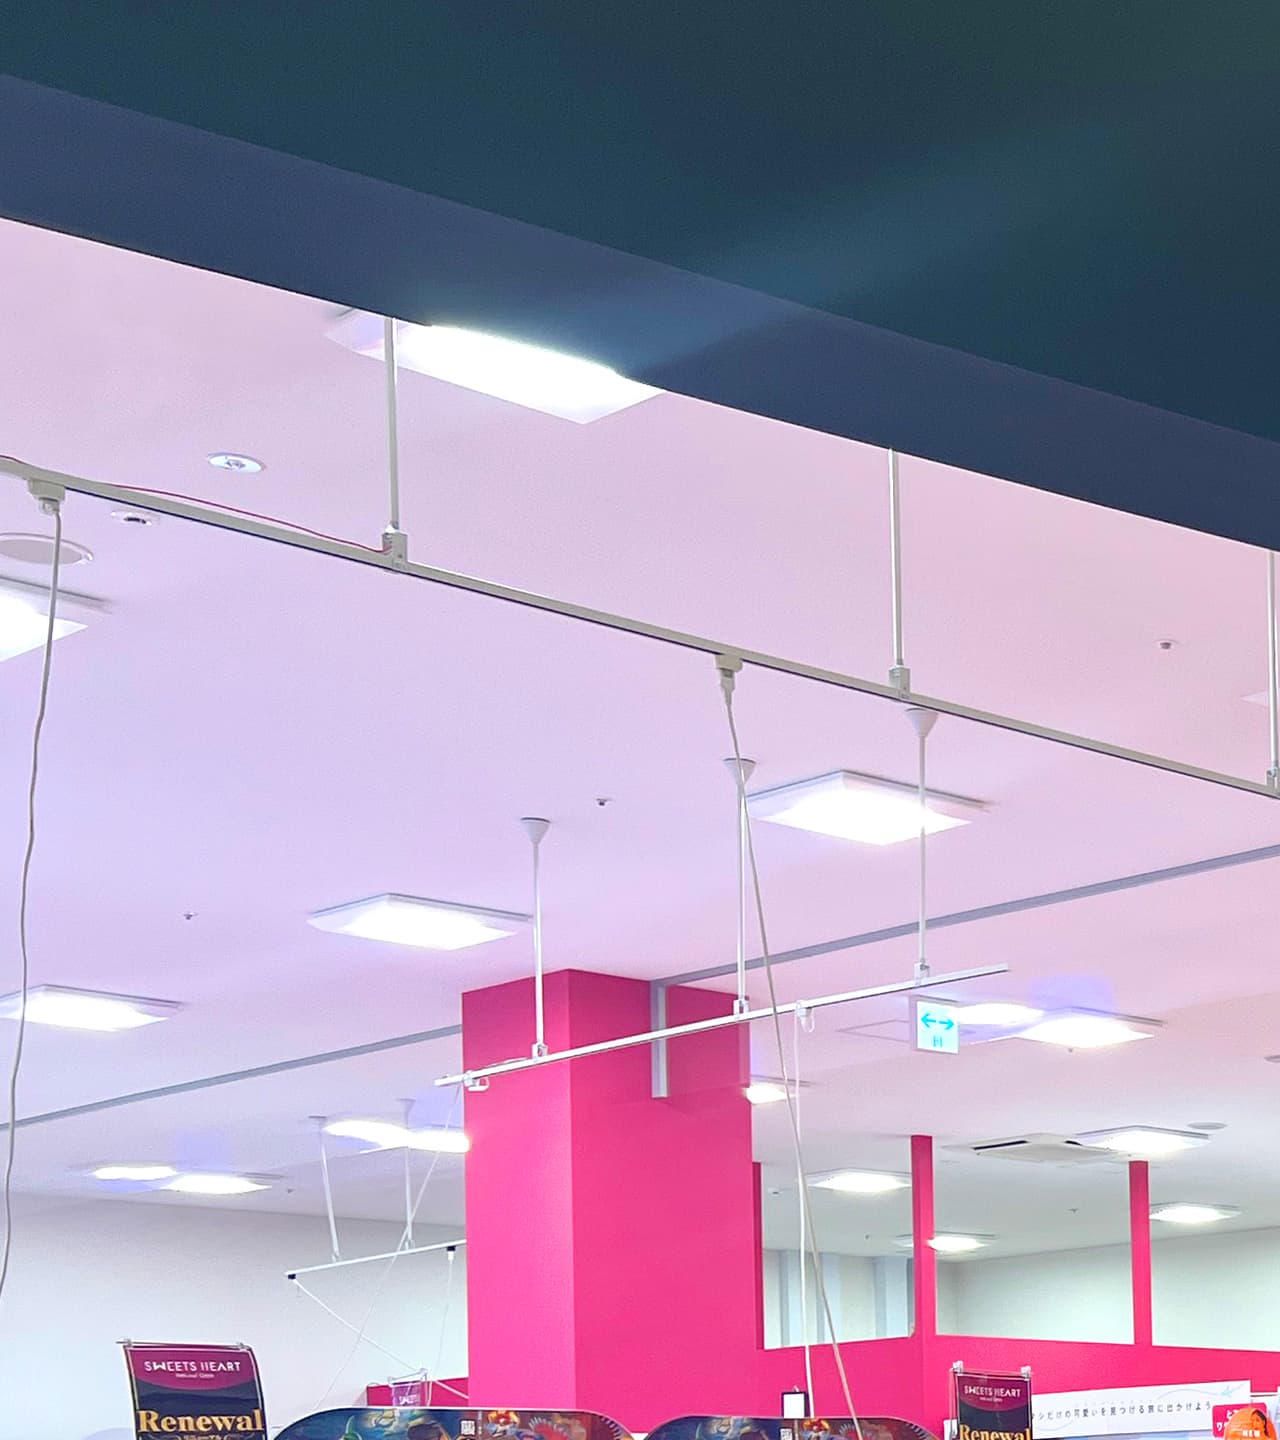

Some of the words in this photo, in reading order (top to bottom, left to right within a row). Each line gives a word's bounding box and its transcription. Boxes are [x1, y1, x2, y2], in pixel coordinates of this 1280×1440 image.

[144, 1361, 197, 1372] SWEETS
[200, 1361, 241, 1372] HEART
[137, 1408, 264, 1433] Renewal
